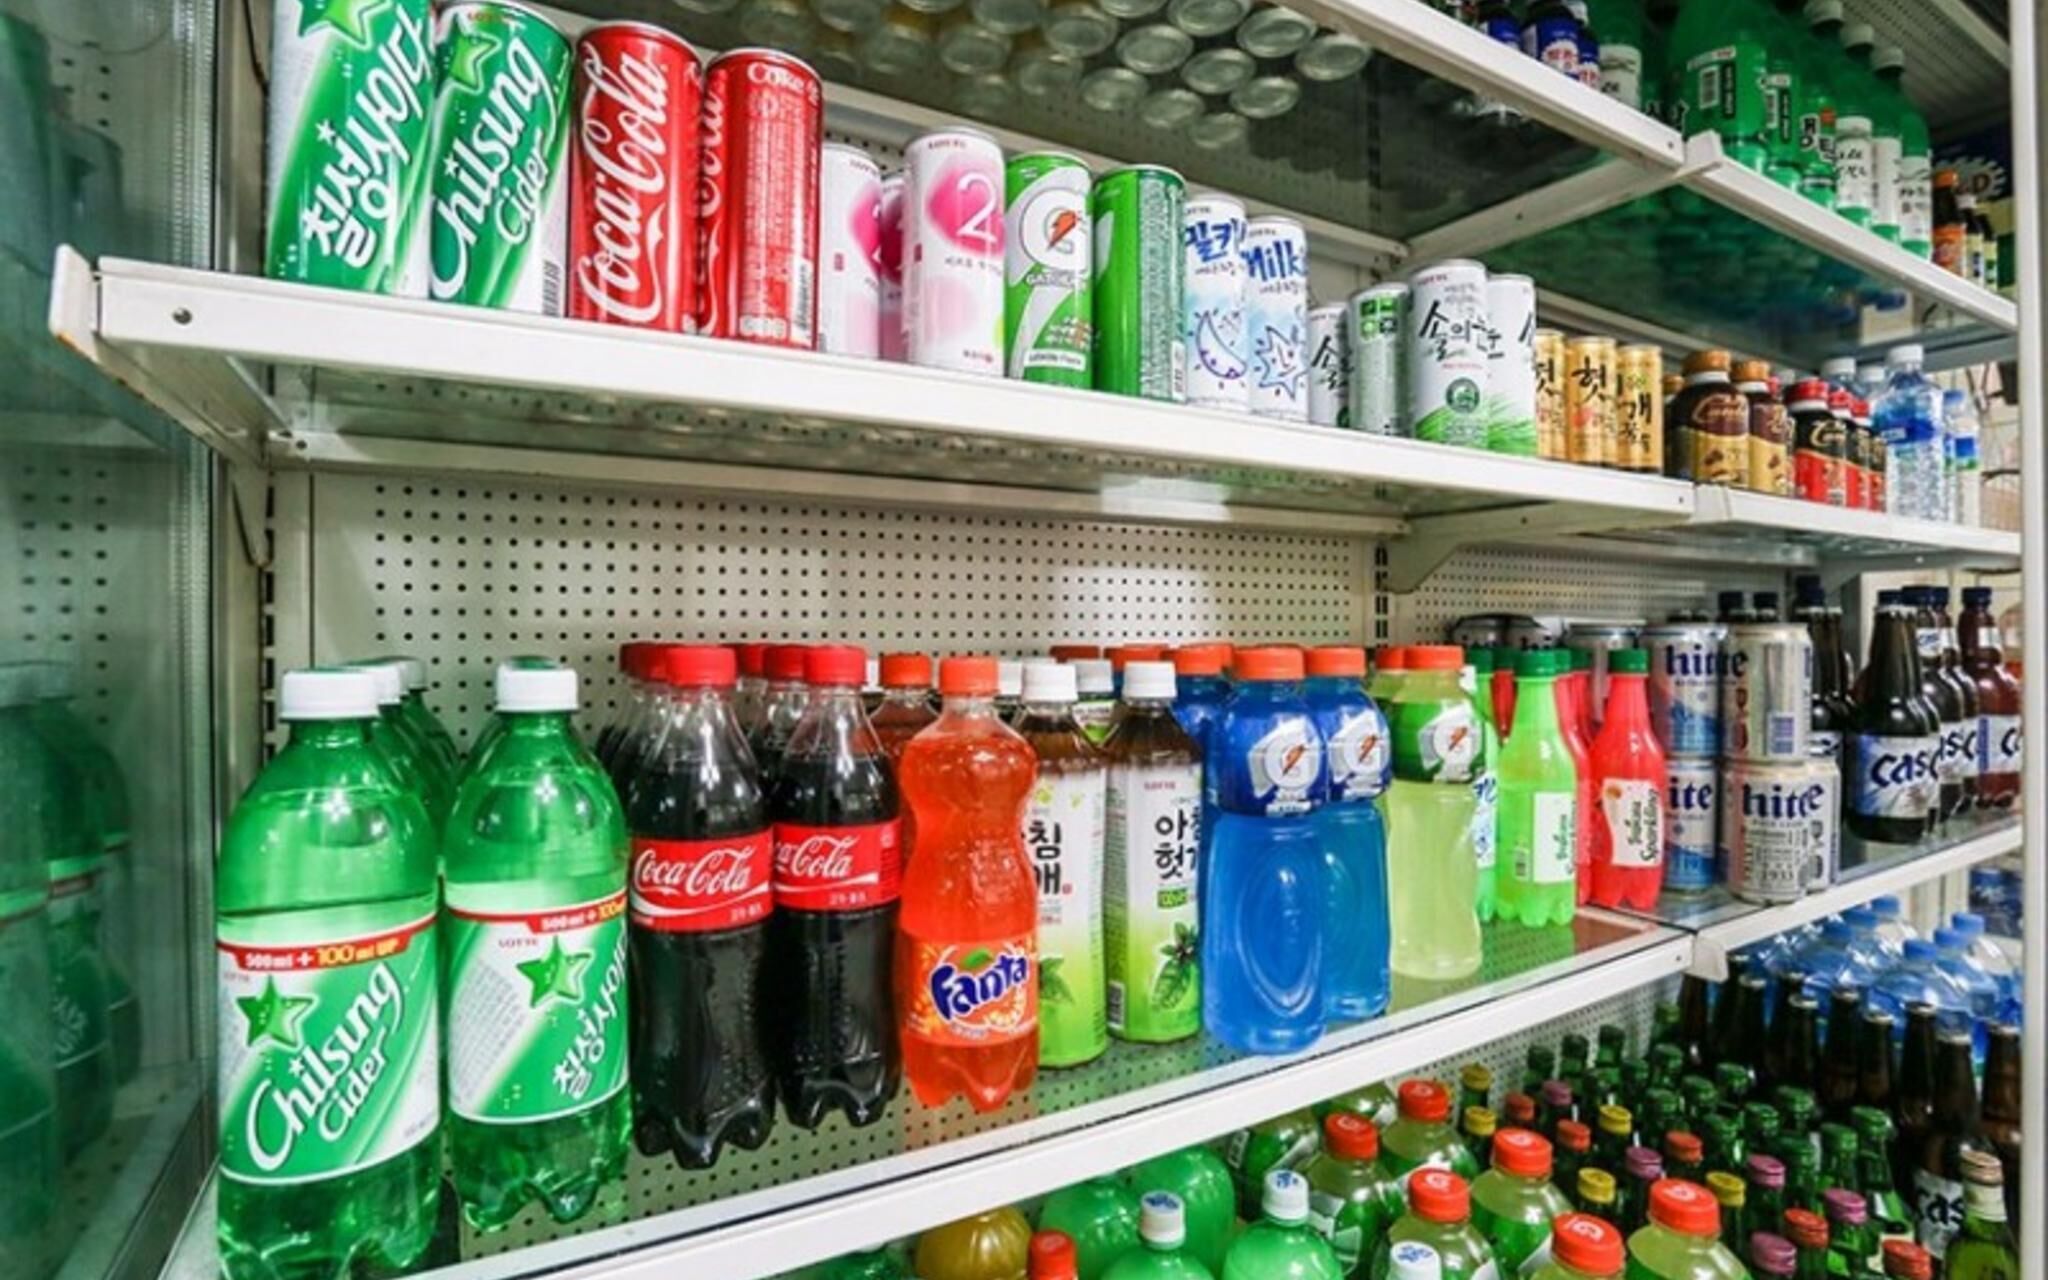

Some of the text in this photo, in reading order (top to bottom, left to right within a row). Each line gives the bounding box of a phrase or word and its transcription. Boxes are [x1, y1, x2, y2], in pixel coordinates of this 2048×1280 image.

[301, 4, 433, 268] 칠성사이다
[430, 37, 556, 299] Chilsung
[494, 127, 549, 244] Cider
[957, 171, 997, 242] 2
[316, 944, 354, 965] 100
[930, 953, 1030, 1022] Fanta
[246, 962, 403, 1171] Chilsung
[318, 1025, 388, 1142] Cider
